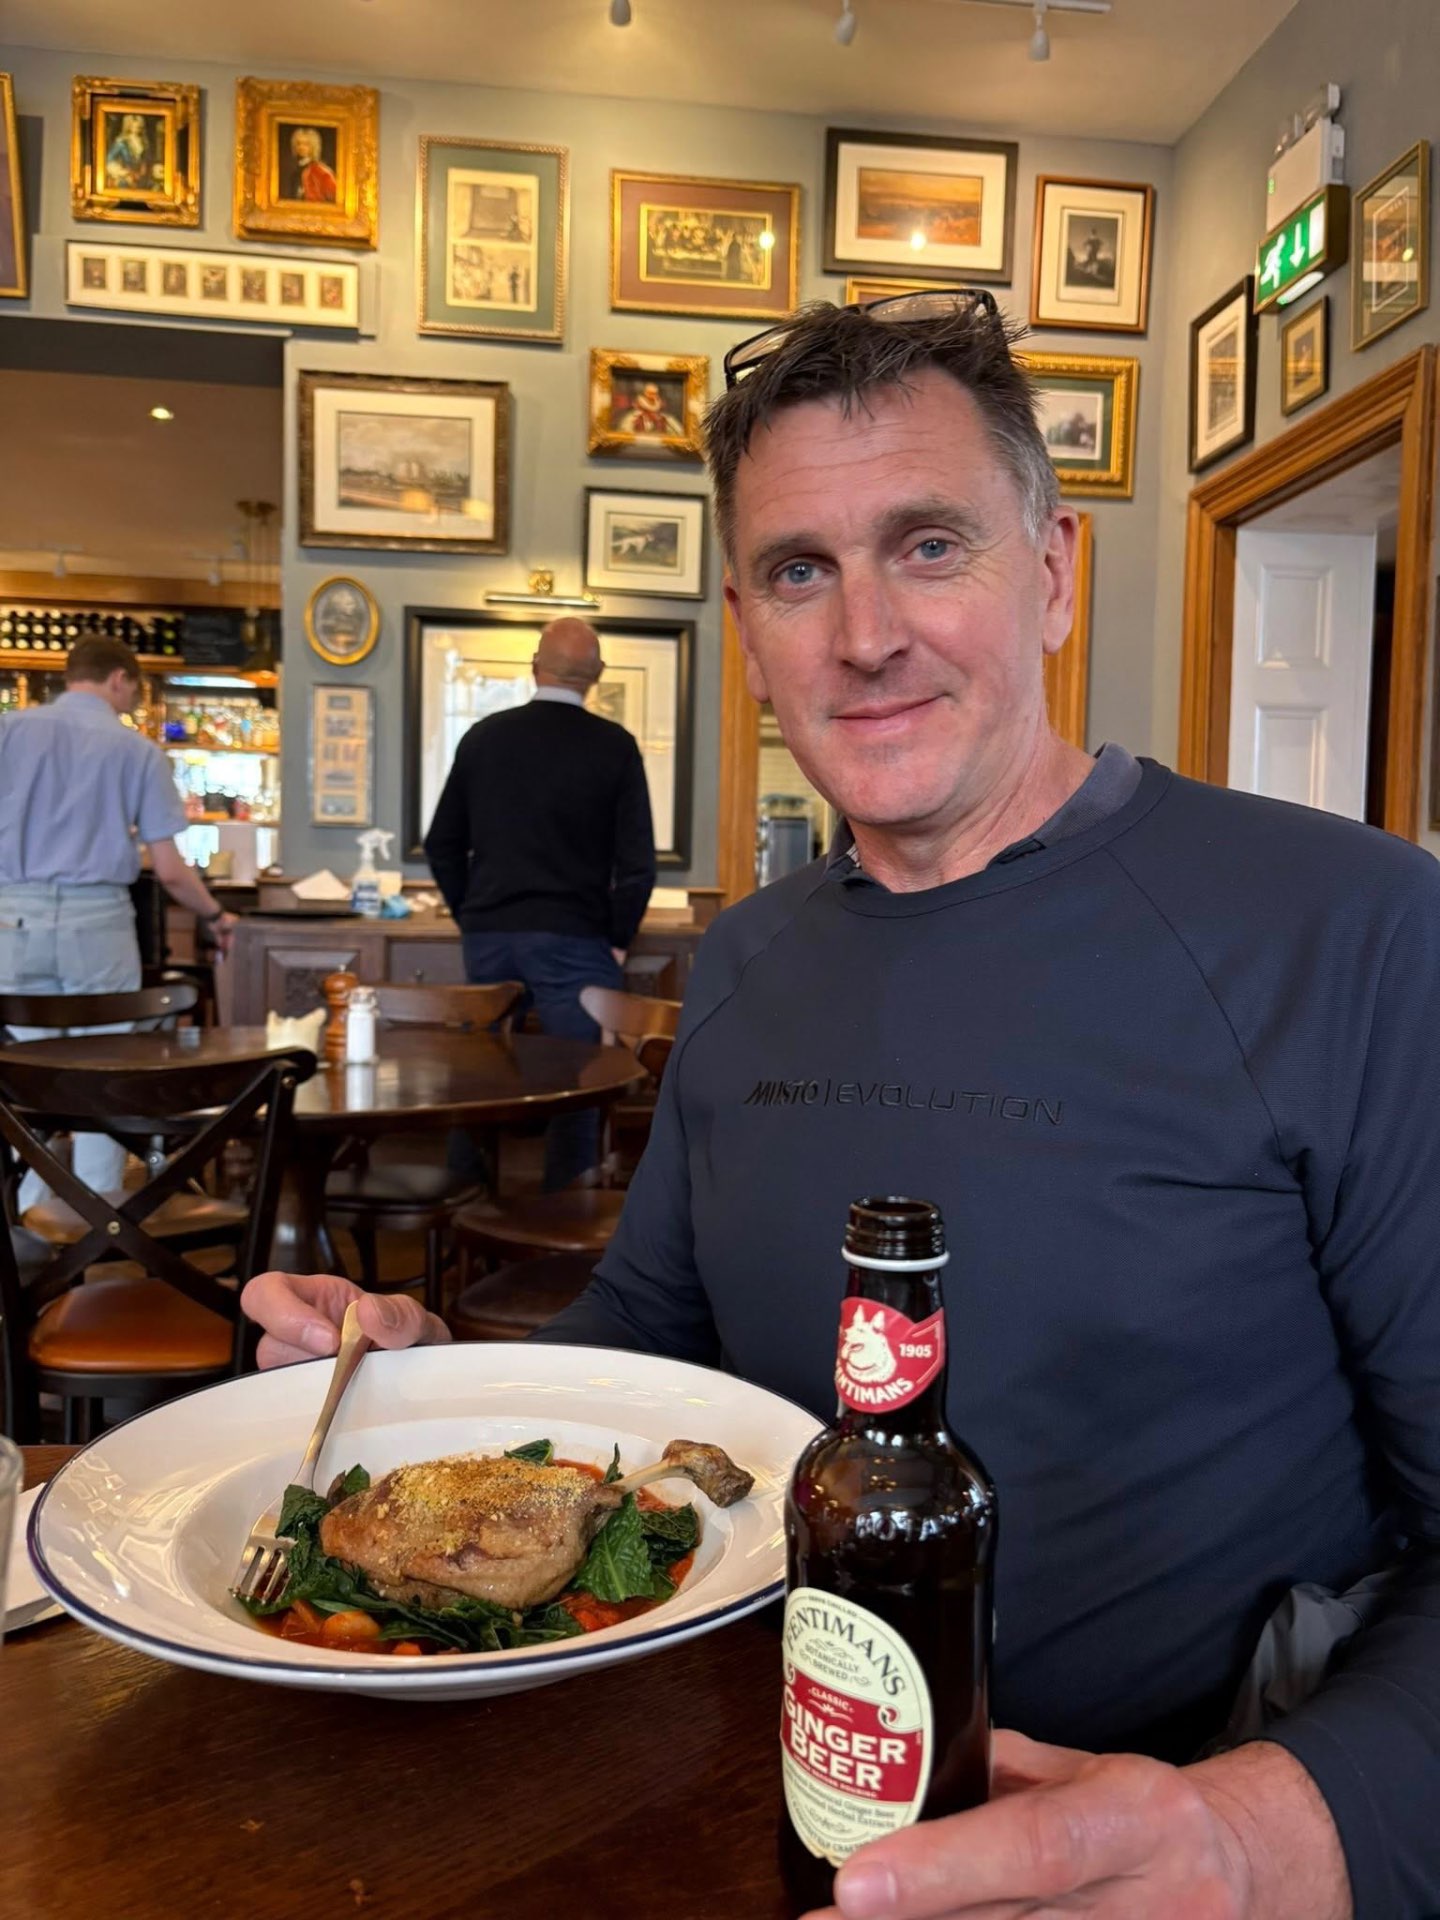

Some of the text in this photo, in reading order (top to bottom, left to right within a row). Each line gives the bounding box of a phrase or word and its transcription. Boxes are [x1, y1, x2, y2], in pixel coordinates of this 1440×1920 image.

[836, 1083, 1064, 1126] EVOLUTION
[899, 1343, 932, 1358] 1905
[838, 1372, 914, 1405] NTIMANS
[784, 1606, 906, 1696] FENTIMANS
[804, 1643, 860, 1673] BOTANICALLY
[813, 1658, 849, 1681] BREWED
[811, 1687, 850, 1710] CLASSIC
[784, 1685, 907, 1765] GINGER
[790, 1720, 883, 1791] BEER
